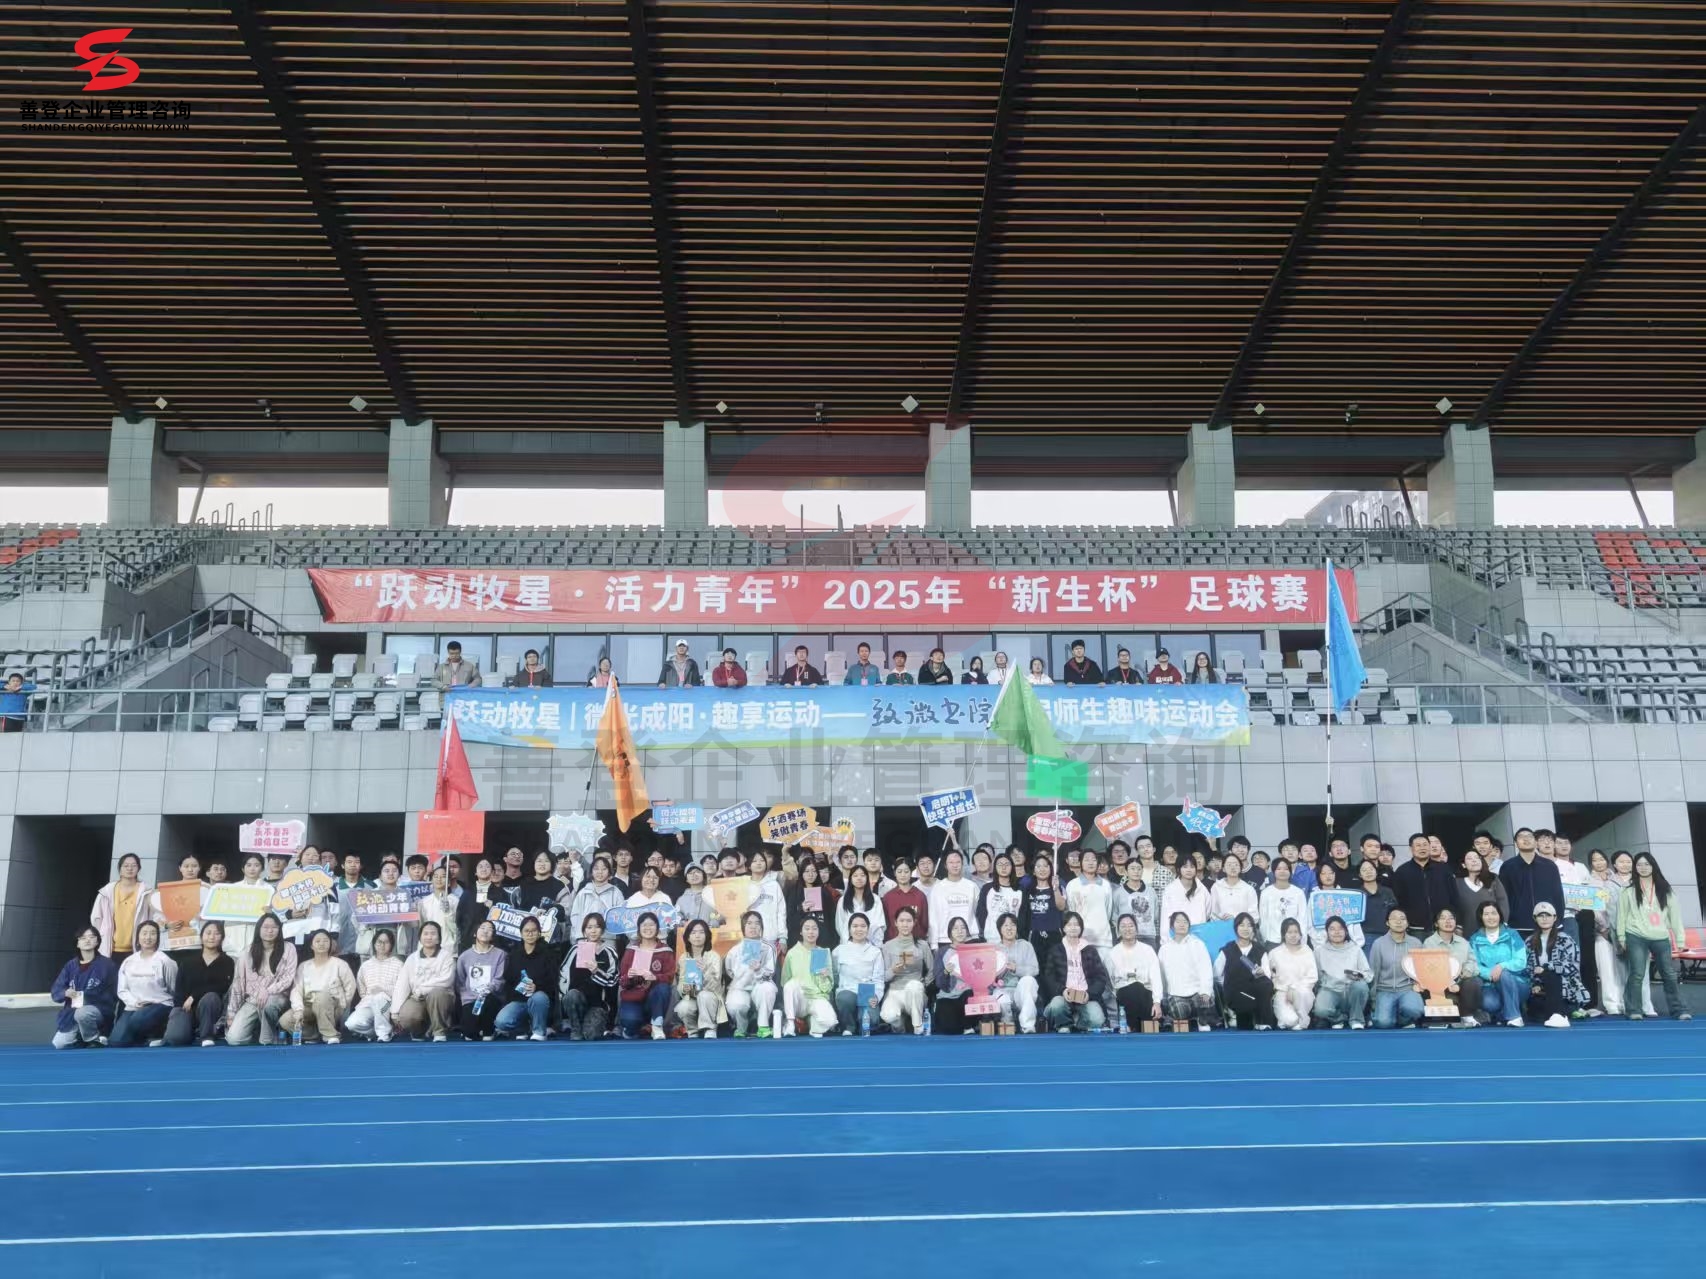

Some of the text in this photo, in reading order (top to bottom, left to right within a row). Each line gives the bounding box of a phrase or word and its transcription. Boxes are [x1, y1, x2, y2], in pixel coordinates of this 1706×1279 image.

[823, 576, 964, 613] 2025年
[988, 574, 1158, 613] “新生杯”
[1185, 574, 1309, 613] 足球赛
[768, 808, 807, 827] 汗洒赛场
[928, 799, 975, 822] 快乐共成长
[770, 819, 809, 839] 笑傲青春
